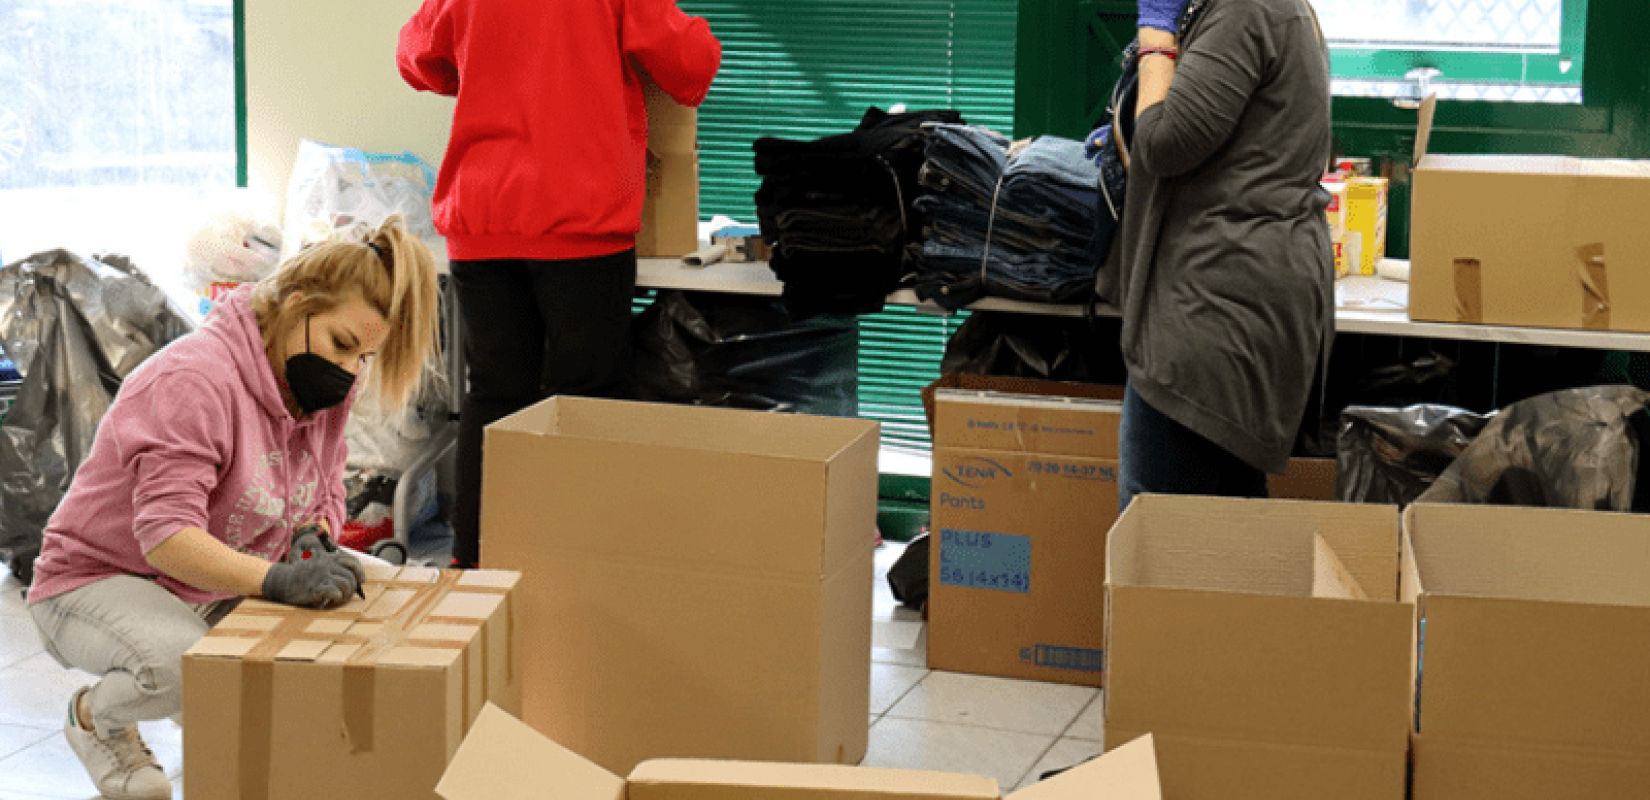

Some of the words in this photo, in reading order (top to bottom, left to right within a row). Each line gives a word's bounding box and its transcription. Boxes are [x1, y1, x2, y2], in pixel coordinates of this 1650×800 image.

[958, 465, 996, 480] TENA
[940, 492, 986, 510] Pants
[942, 529, 992, 548] PLUS
[941, 550, 951, 563] L
